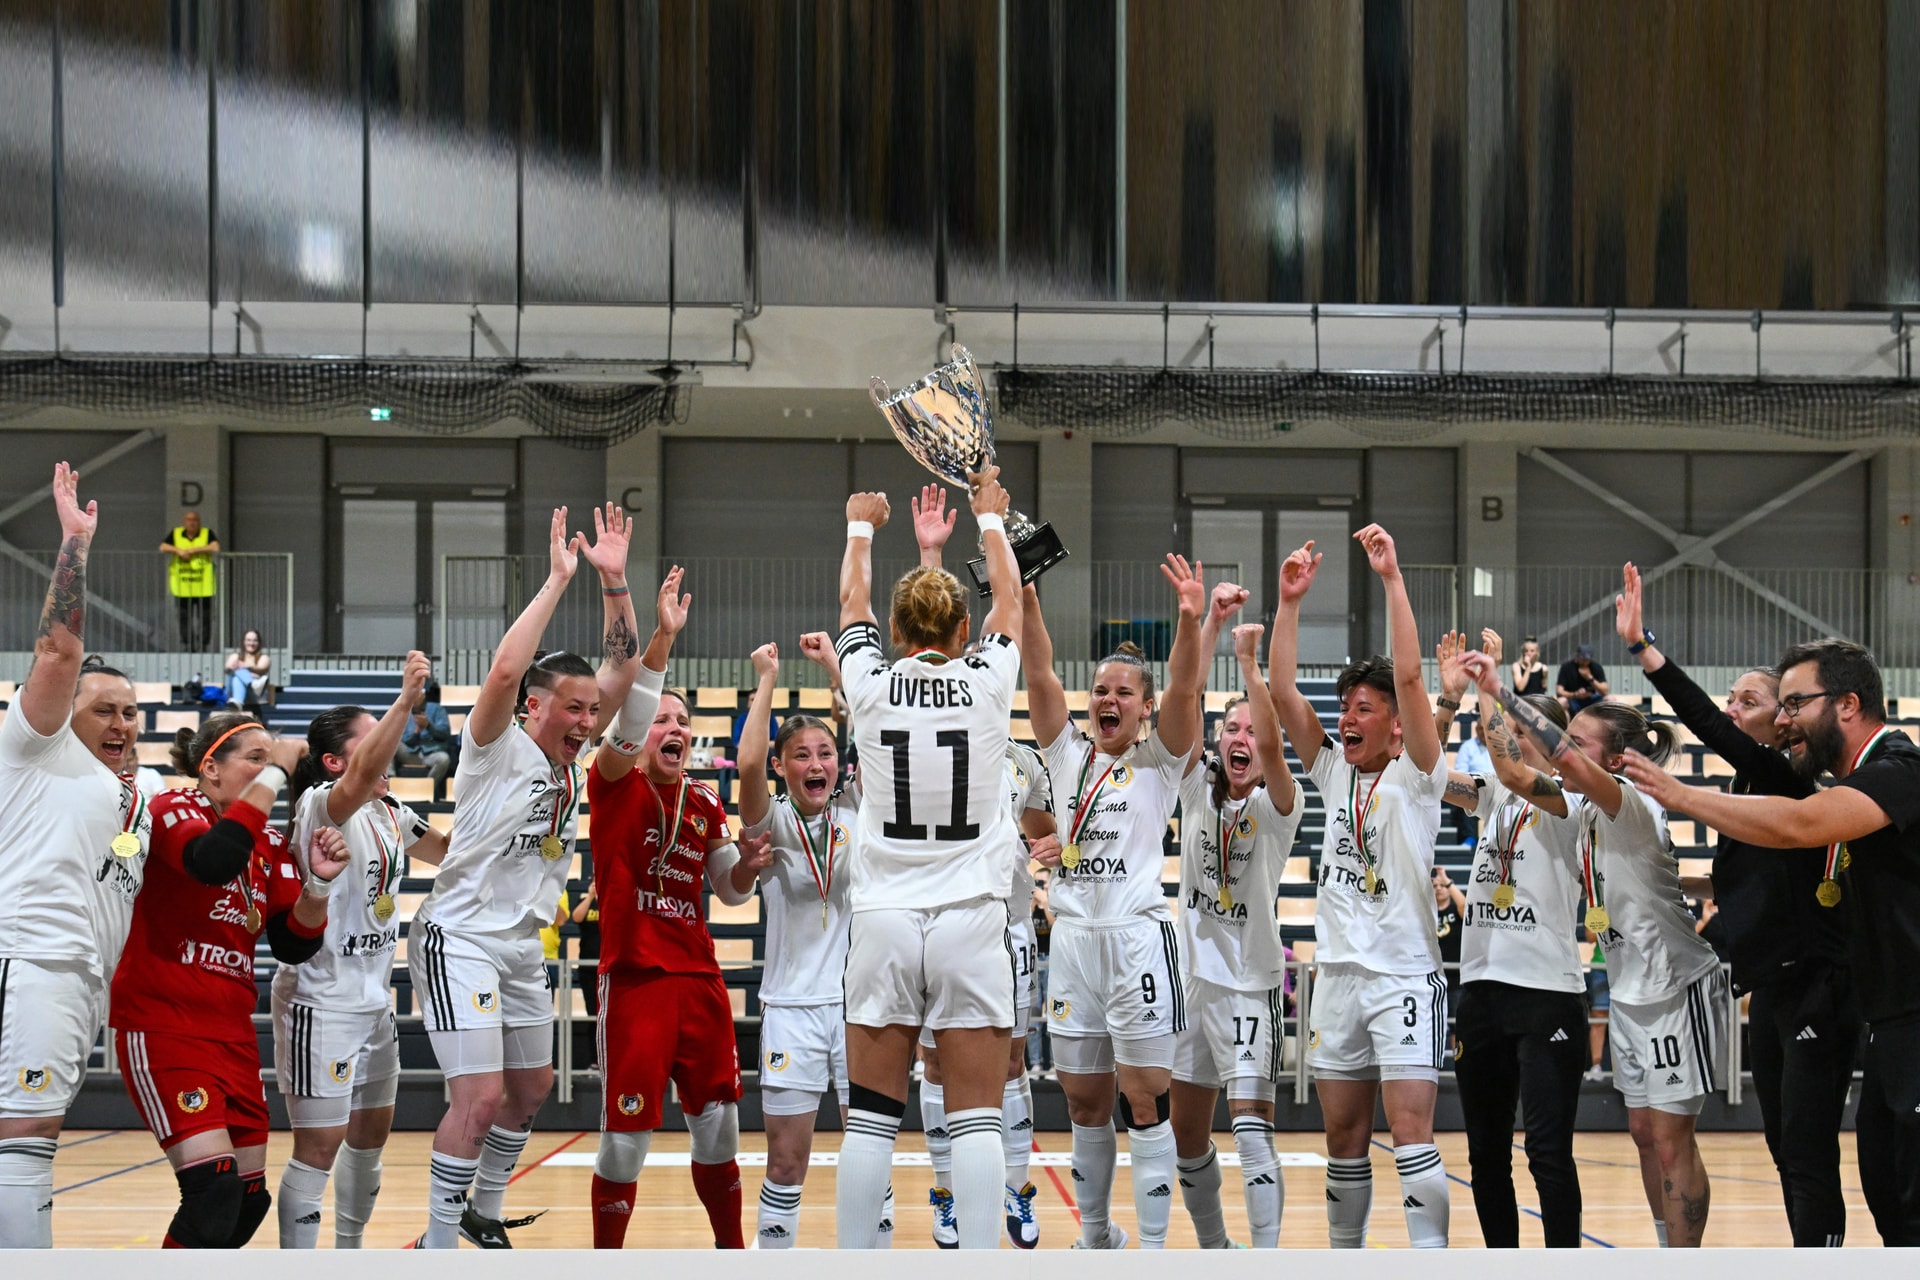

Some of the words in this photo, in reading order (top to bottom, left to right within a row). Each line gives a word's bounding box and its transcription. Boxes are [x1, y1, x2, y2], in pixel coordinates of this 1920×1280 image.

[182, 481, 204, 507] D
[622, 487, 642, 512] C
[1482, 497, 1503, 521] B
[889, 672, 973, 709] ÜVEGES
[880, 729, 980, 841] 11
[115, 861, 140, 897] TROY
[1336, 866, 1389, 895] TROA
[1477, 901, 1537, 924] TROYA
[1141, 972, 1156, 1004] 9
[1403, 996, 1417, 1028] 3
[1233, 1016, 1259, 1046] 17
[1651, 1034, 1681, 1070] 10
[760, 1229, 790, 1239] adidas
